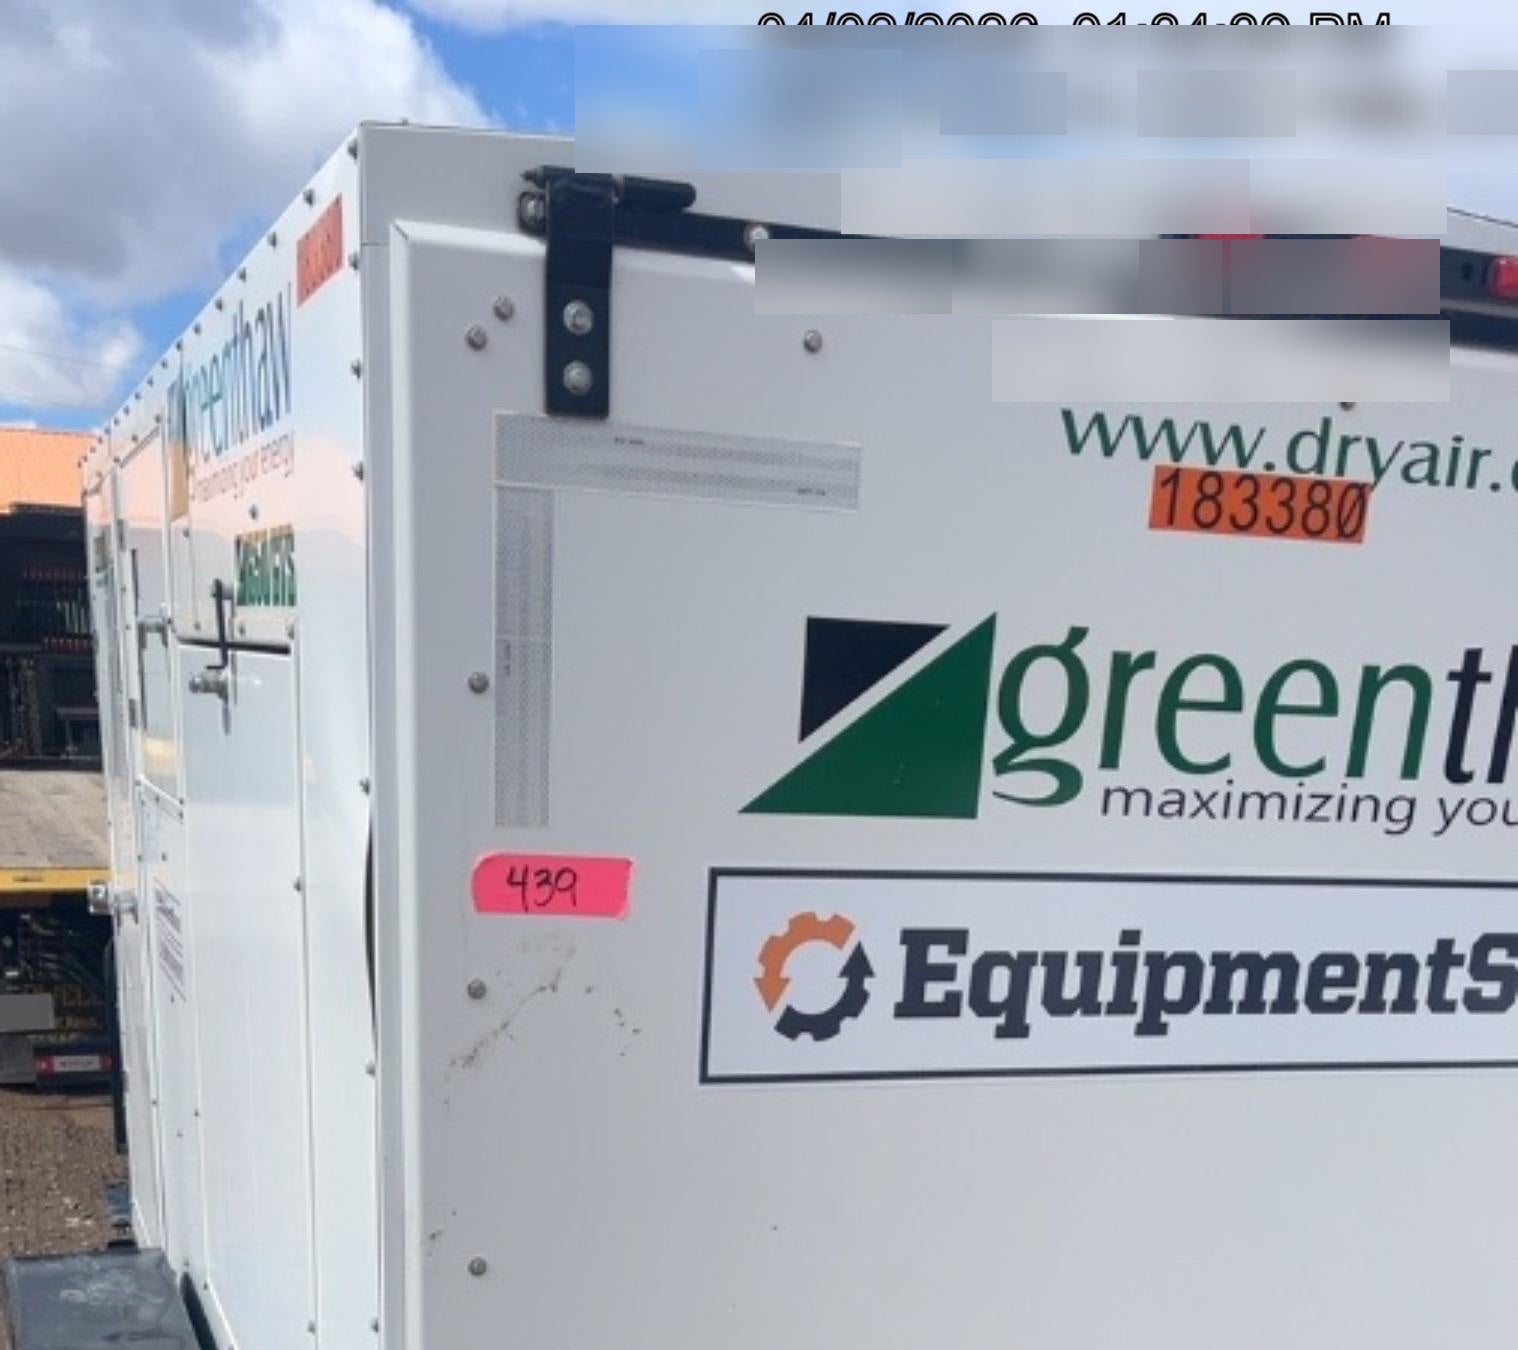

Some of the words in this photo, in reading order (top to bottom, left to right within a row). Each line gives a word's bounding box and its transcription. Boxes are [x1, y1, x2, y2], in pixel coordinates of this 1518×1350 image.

[1061, 407, 1518, 493] www.dryair.
[1159, 466, 1369, 539] 183380
[1101, 777, 1416, 836] maximizing
[506, 863, 577, 913] 439
